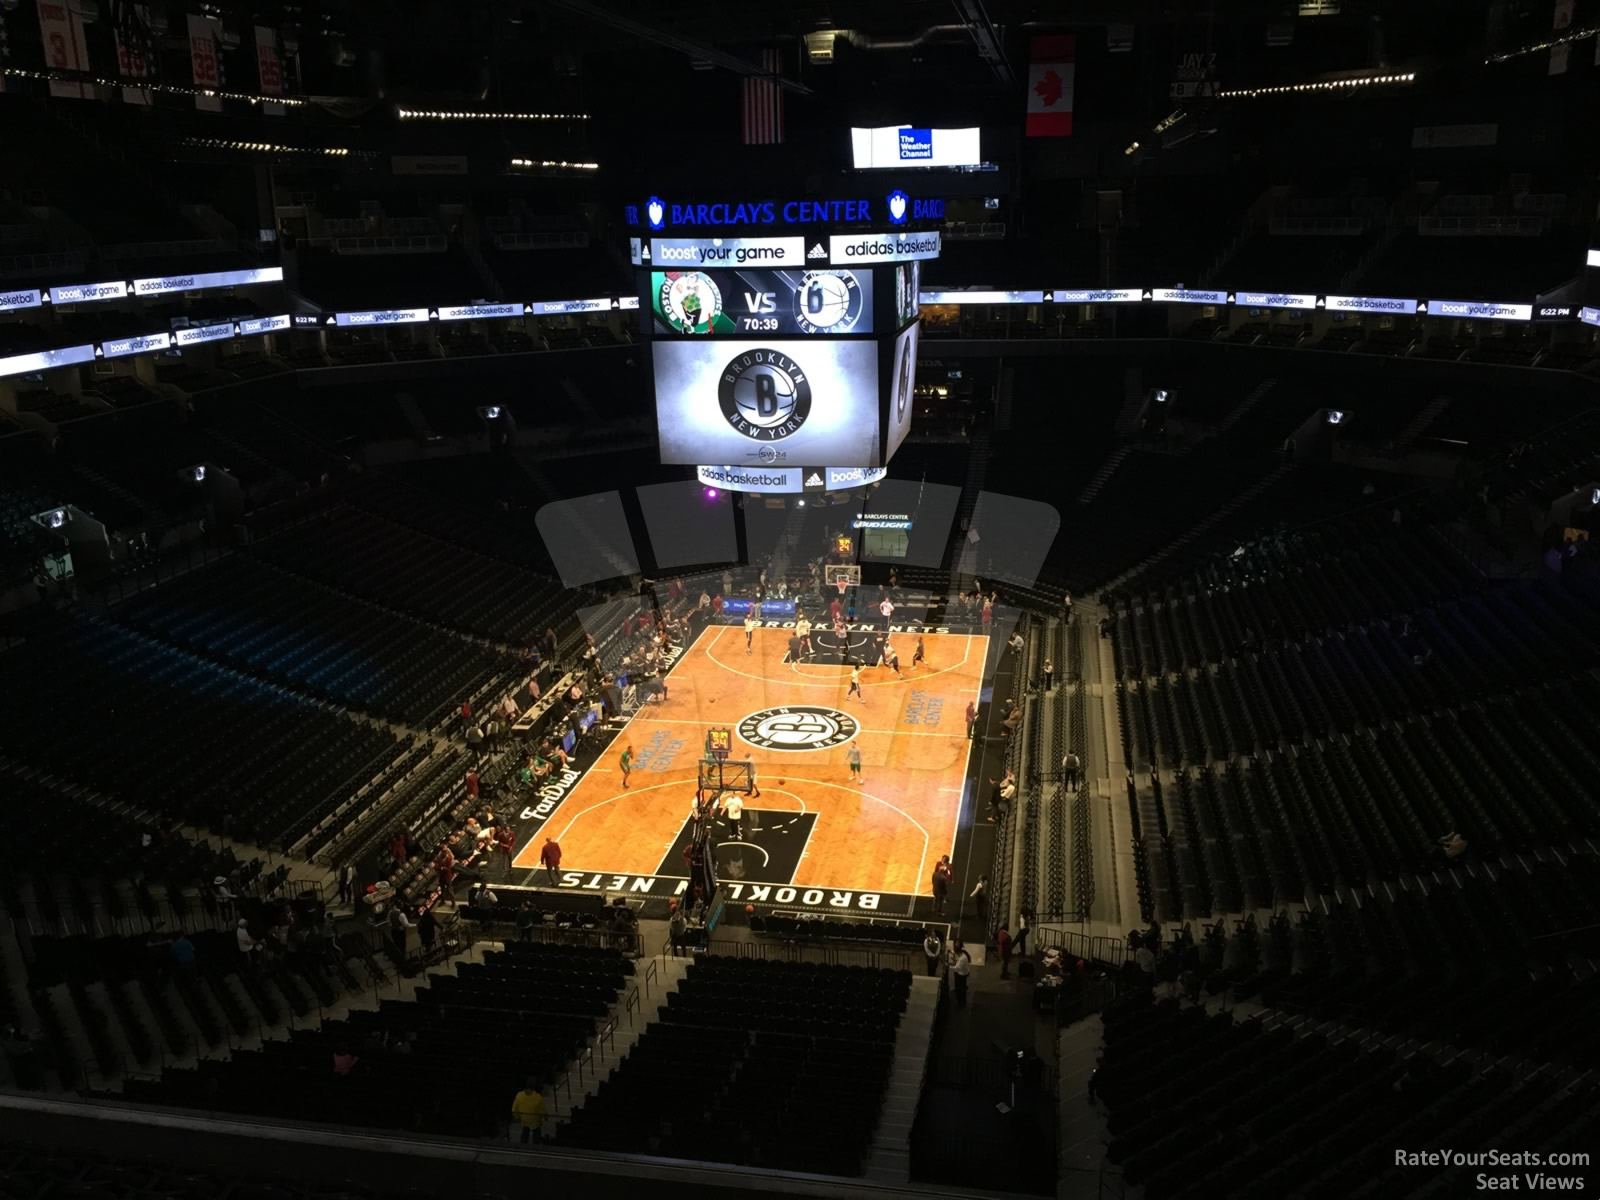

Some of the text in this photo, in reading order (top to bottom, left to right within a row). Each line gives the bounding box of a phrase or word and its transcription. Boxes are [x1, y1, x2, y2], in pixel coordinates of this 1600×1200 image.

[1177, 53, 1204, 69] JAY
[900, 135, 914, 143] The
[901, 142, 931, 150] Weather
[901, 149, 931, 158] Channel
[671, 200, 872, 225] BARCLAYS CENTER
[661, 244, 785, 264] boost your game
[845, 240, 894, 257] adidas
[140, 278, 194, 291] adidas basketball
[58, 286, 120, 300] boost your game
[1066, 291, 1129, 302] boost your game
[1164, 291, 1218, 300] adidas basketball
[544, 301, 600, 312] boost your game
[744, 291, 777, 314] VS
[1247, 295, 1304, 307] boost your game
[1337, 299, 1405, 310] adidas basketball
[450, 305, 514, 316] adidas basketball
[1442, 303, 1516, 317] boost your game
[1540, 308, 1570, 316] 6:22 PM
[350, 312, 416, 324] boost your game
[743, 318, 779, 331] 70:39
[182, 326, 229, 342] adidas basketball
[111, 337, 163, 353] boost your game
[725, 352, 805, 384] BROOKLYN
[755, 374, 778, 418] B
[730, 412, 760, 438] NEW
[769, 413, 804, 439] YORK
[701, 467, 787, 487] adidas basketball
[831, 468, 863, 483] boost
[880, 521, 911, 529] LIGHT
[888, 625, 950, 634] NETS
[741, 708, 790, 747] BROOKLYN
[826, 711, 855, 731] YORK
[712, 738, 728, 749] 24
[812, 732, 848, 748] NEW
[519, 769, 582, 820] FanDuel
[558, 872, 881, 909] BROOKLN NETS
